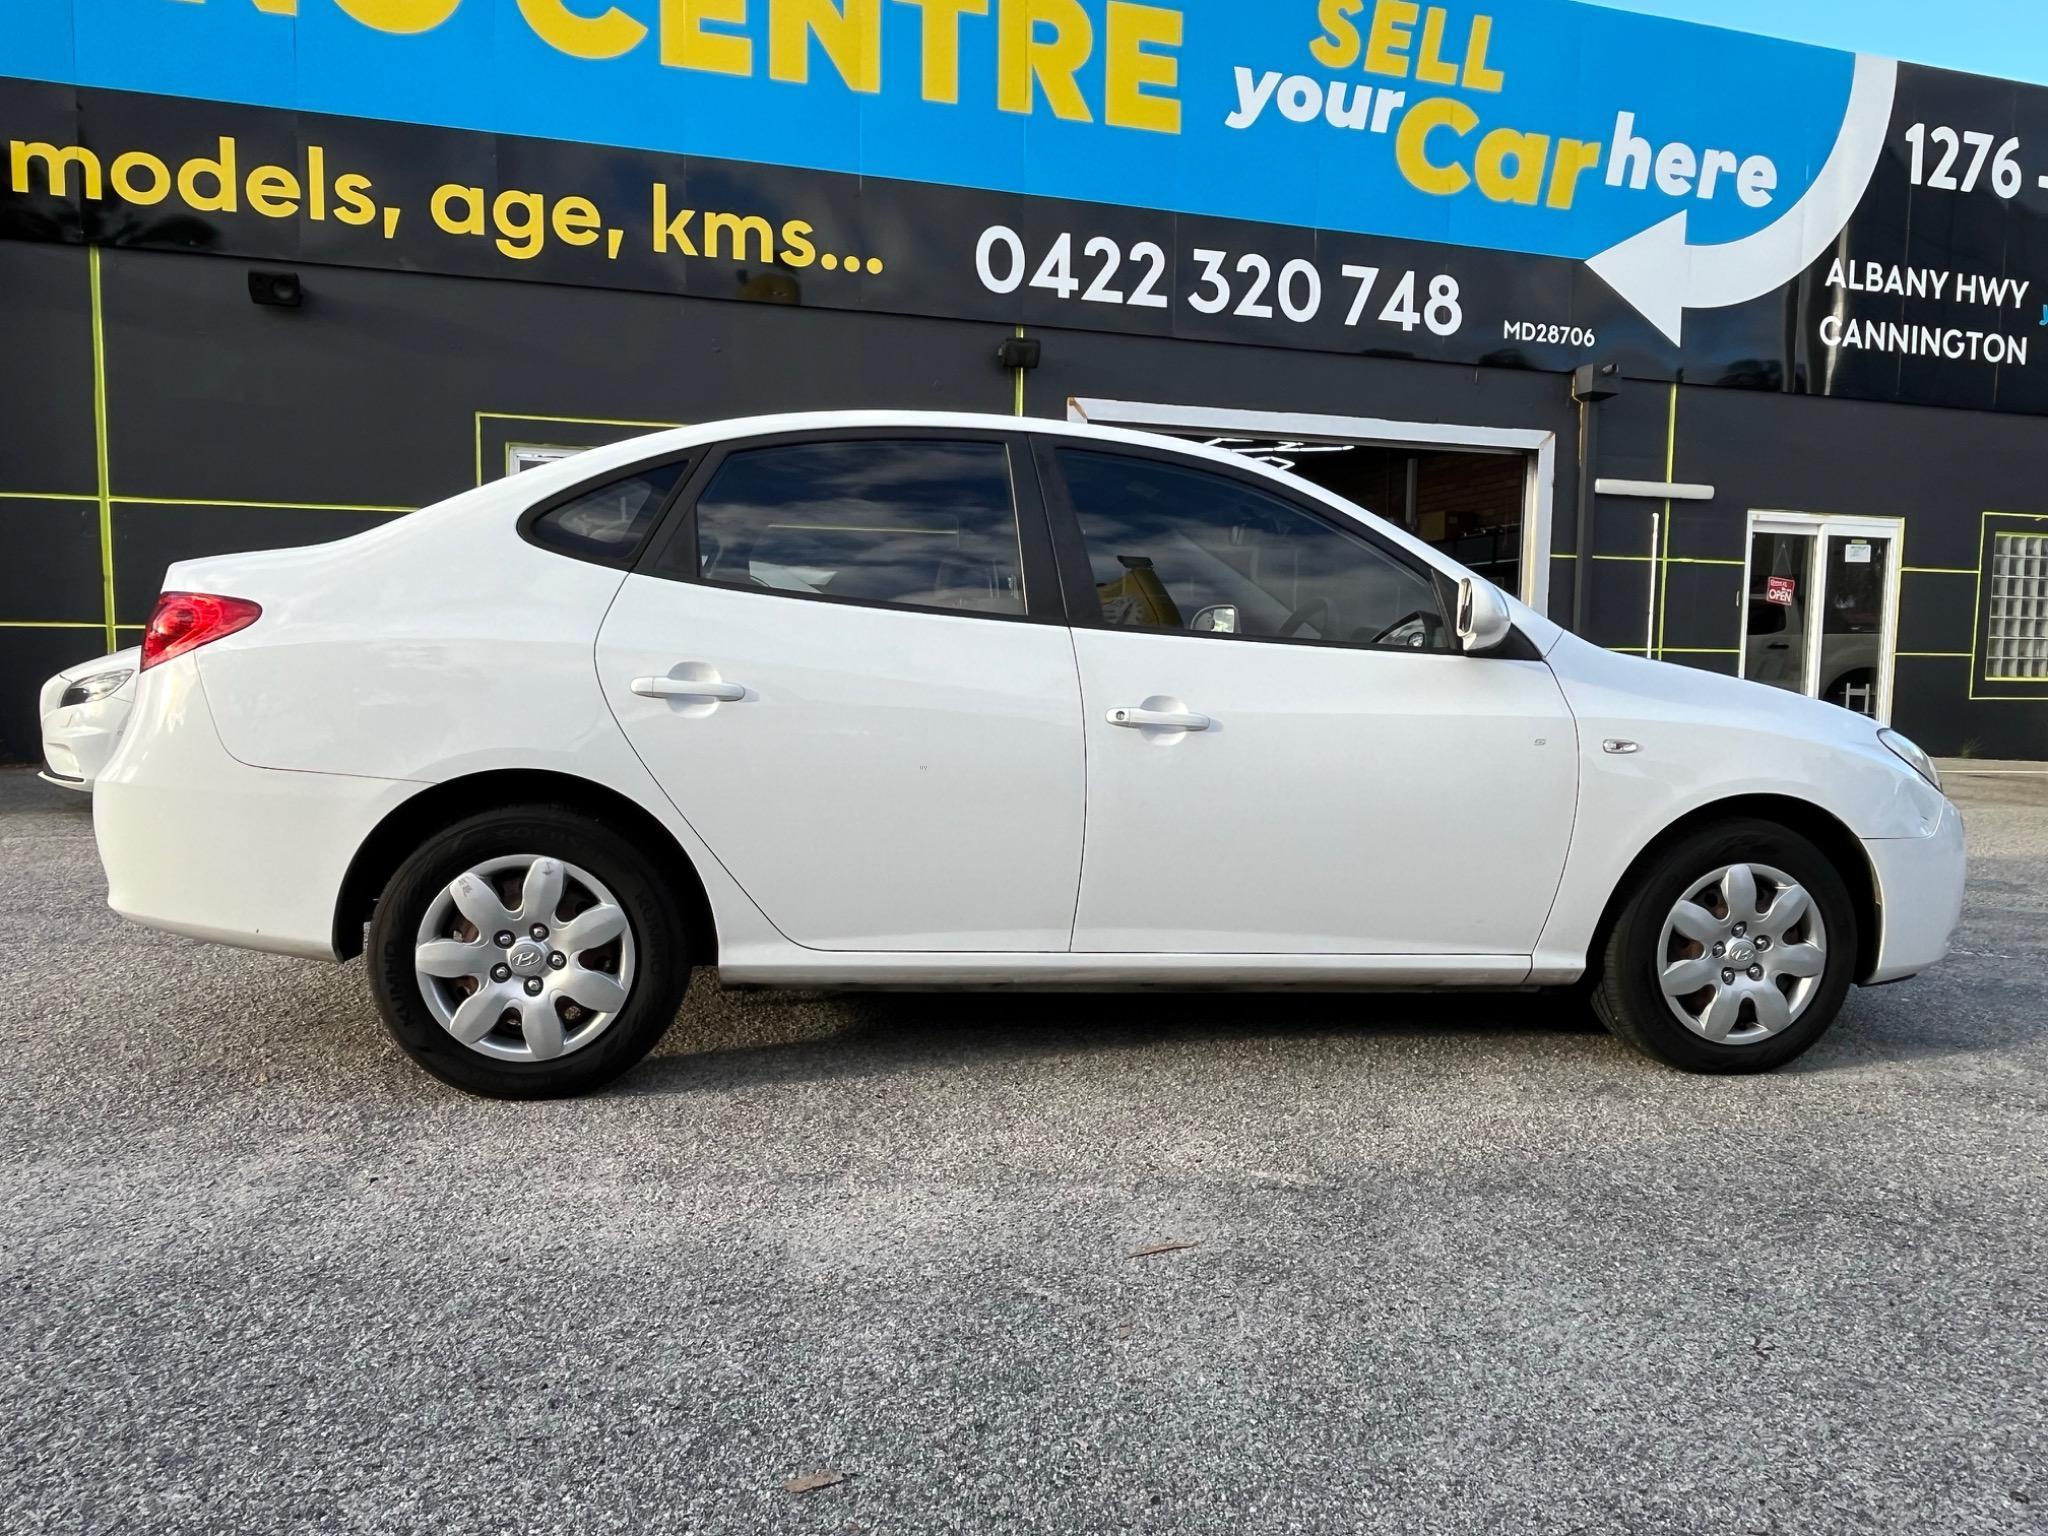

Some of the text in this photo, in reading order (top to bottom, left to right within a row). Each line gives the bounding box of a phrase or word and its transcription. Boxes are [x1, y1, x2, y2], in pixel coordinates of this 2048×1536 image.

[1308, 0, 1504, 92] SELL
[1224, 66, 1777, 210] your Car here
[1905, 122, 2022, 199] 1276
[9, 136, 884, 274] models, age, kms...
[975, 225, 1463, 336] 0422 320 748
[1824, 257, 2030, 309] ALBANY HWY
[1503, 319, 1596, 347] MD28706
[1819, 314, 2028, 366] CANNINGTON
[1769, 588, 1792, 603] OPEN
